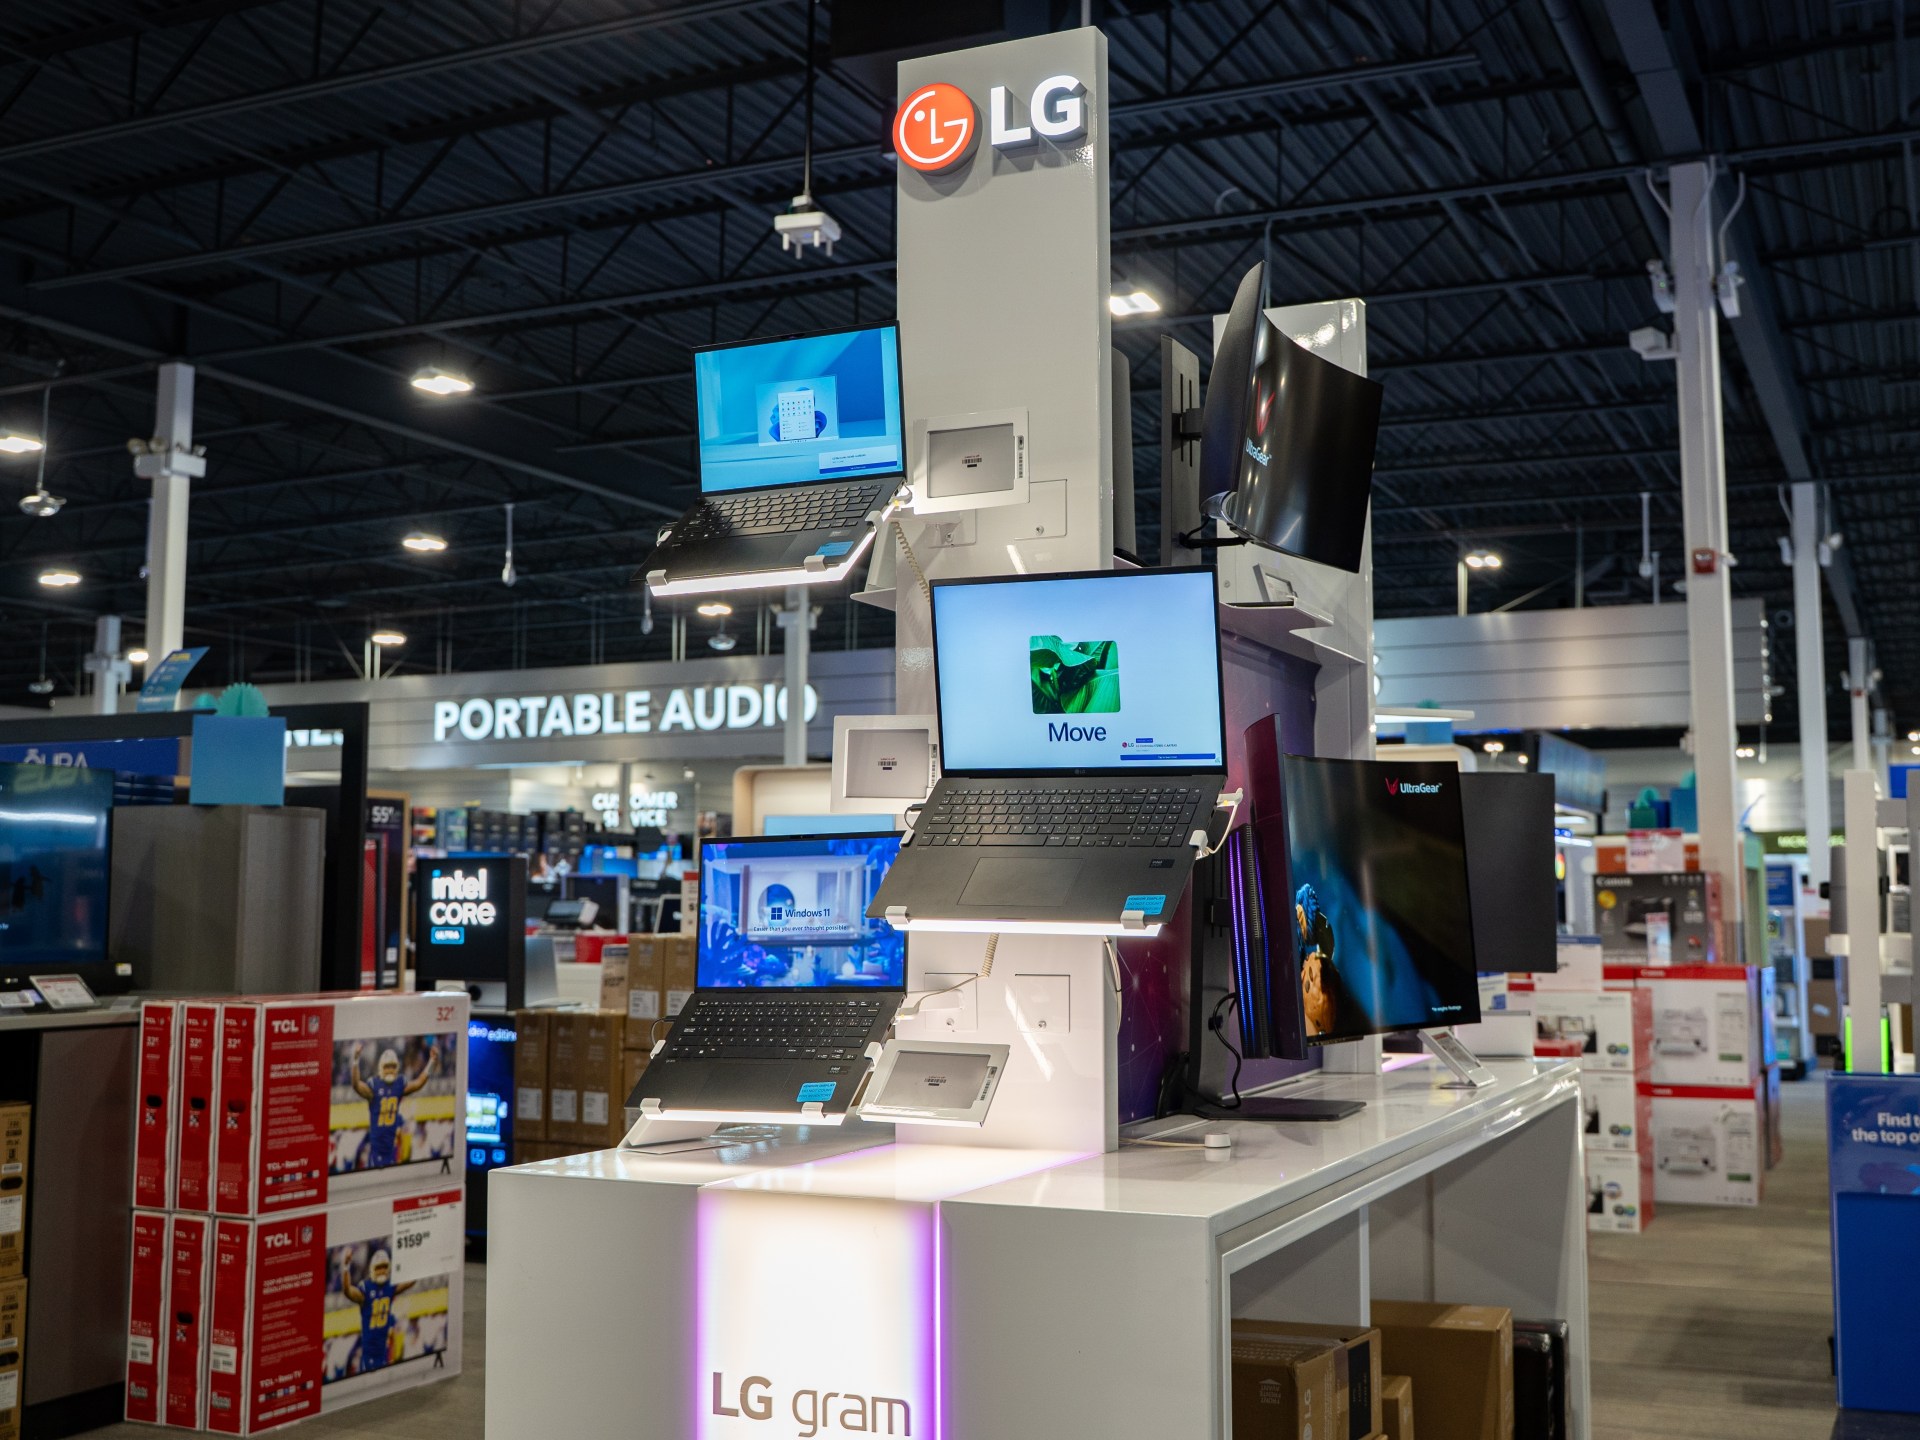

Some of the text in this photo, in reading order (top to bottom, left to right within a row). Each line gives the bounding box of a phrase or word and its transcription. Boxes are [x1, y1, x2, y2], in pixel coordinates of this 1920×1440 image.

[990, 75, 1086, 146] LG
[434, 683, 818, 742] PORTABLE AUDIO
[1048, 721, 1107, 742] Move
[591, 791, 678, 811] CUSOMER
[603, 809, 667, 828] SEVICE
[431, 868, 487, 900] intel
[1596, 876, 1633, 887] Canon
[785, 908, 831, 918] Windows 11
[271, 1019, 299, 1034] TCL
[378, 1097, 398, 1127] 10
[1877, 1112, 1911, 1128] Find
[1852, 1128, 1879, 1143] the
[1880, 1129, 1908, 1146] top
[264, 1232, 292, 1249] TCL
[370, 1296, 390, 1329] 10
[713, 1372, 911, 1438] LG gram
[1304, 1388, 1312, 1419] LG
